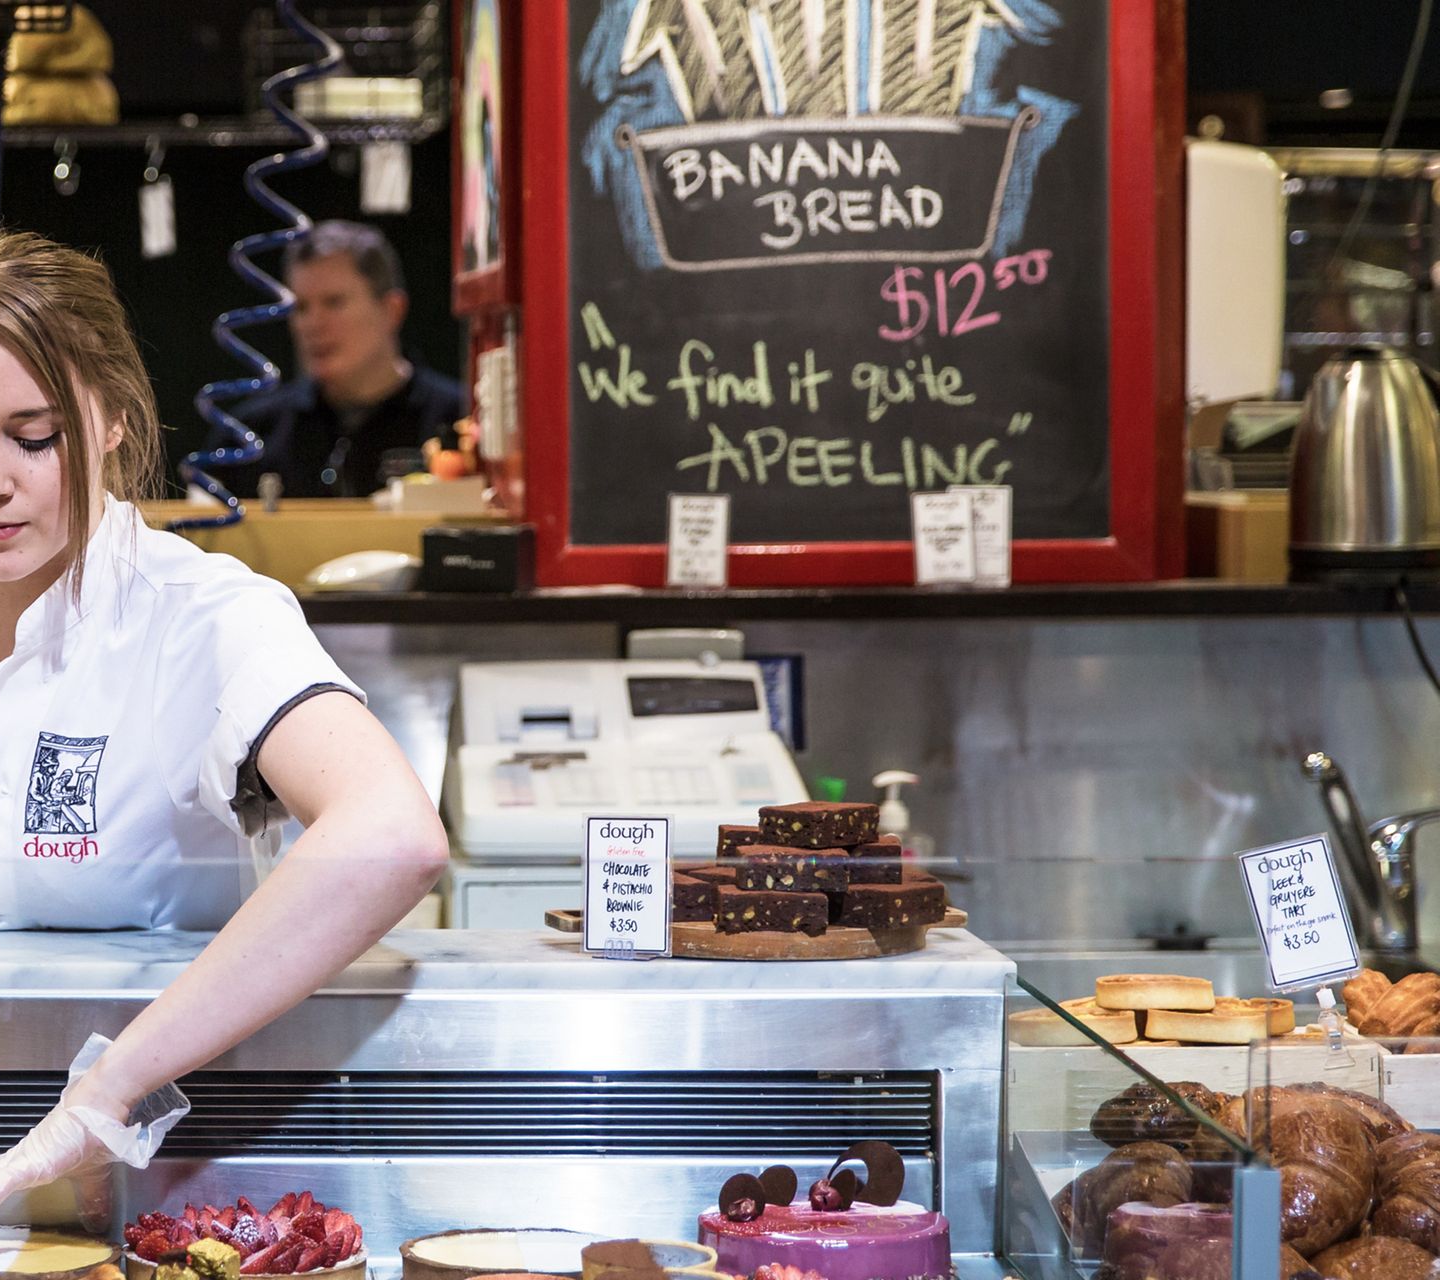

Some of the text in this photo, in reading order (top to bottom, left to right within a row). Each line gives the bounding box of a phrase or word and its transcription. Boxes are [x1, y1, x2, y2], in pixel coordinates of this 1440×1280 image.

[664, 137, 901, 199] BANANA
[755, 184, 944, 250] BREAD
[667, 338, 774, 421] find
[788, 348, 832, 413] it
[851, 354, 976, 423] quite
[600, 822, 654, 845] dough
[23, 835, 99, 864] dough
[1258, 848, 1314, 874] dough
[603, 861, 651, 877] CHOCOLATE
[612, 881, 653, 895] PISTACHIO
[1271, 874, 1297, 891] LEEK
[606, 898, 645, 914] BROWNIE
[1269, 885, 1316, 909] GRUYERE
[1281, 903, 1308, 919] TART
